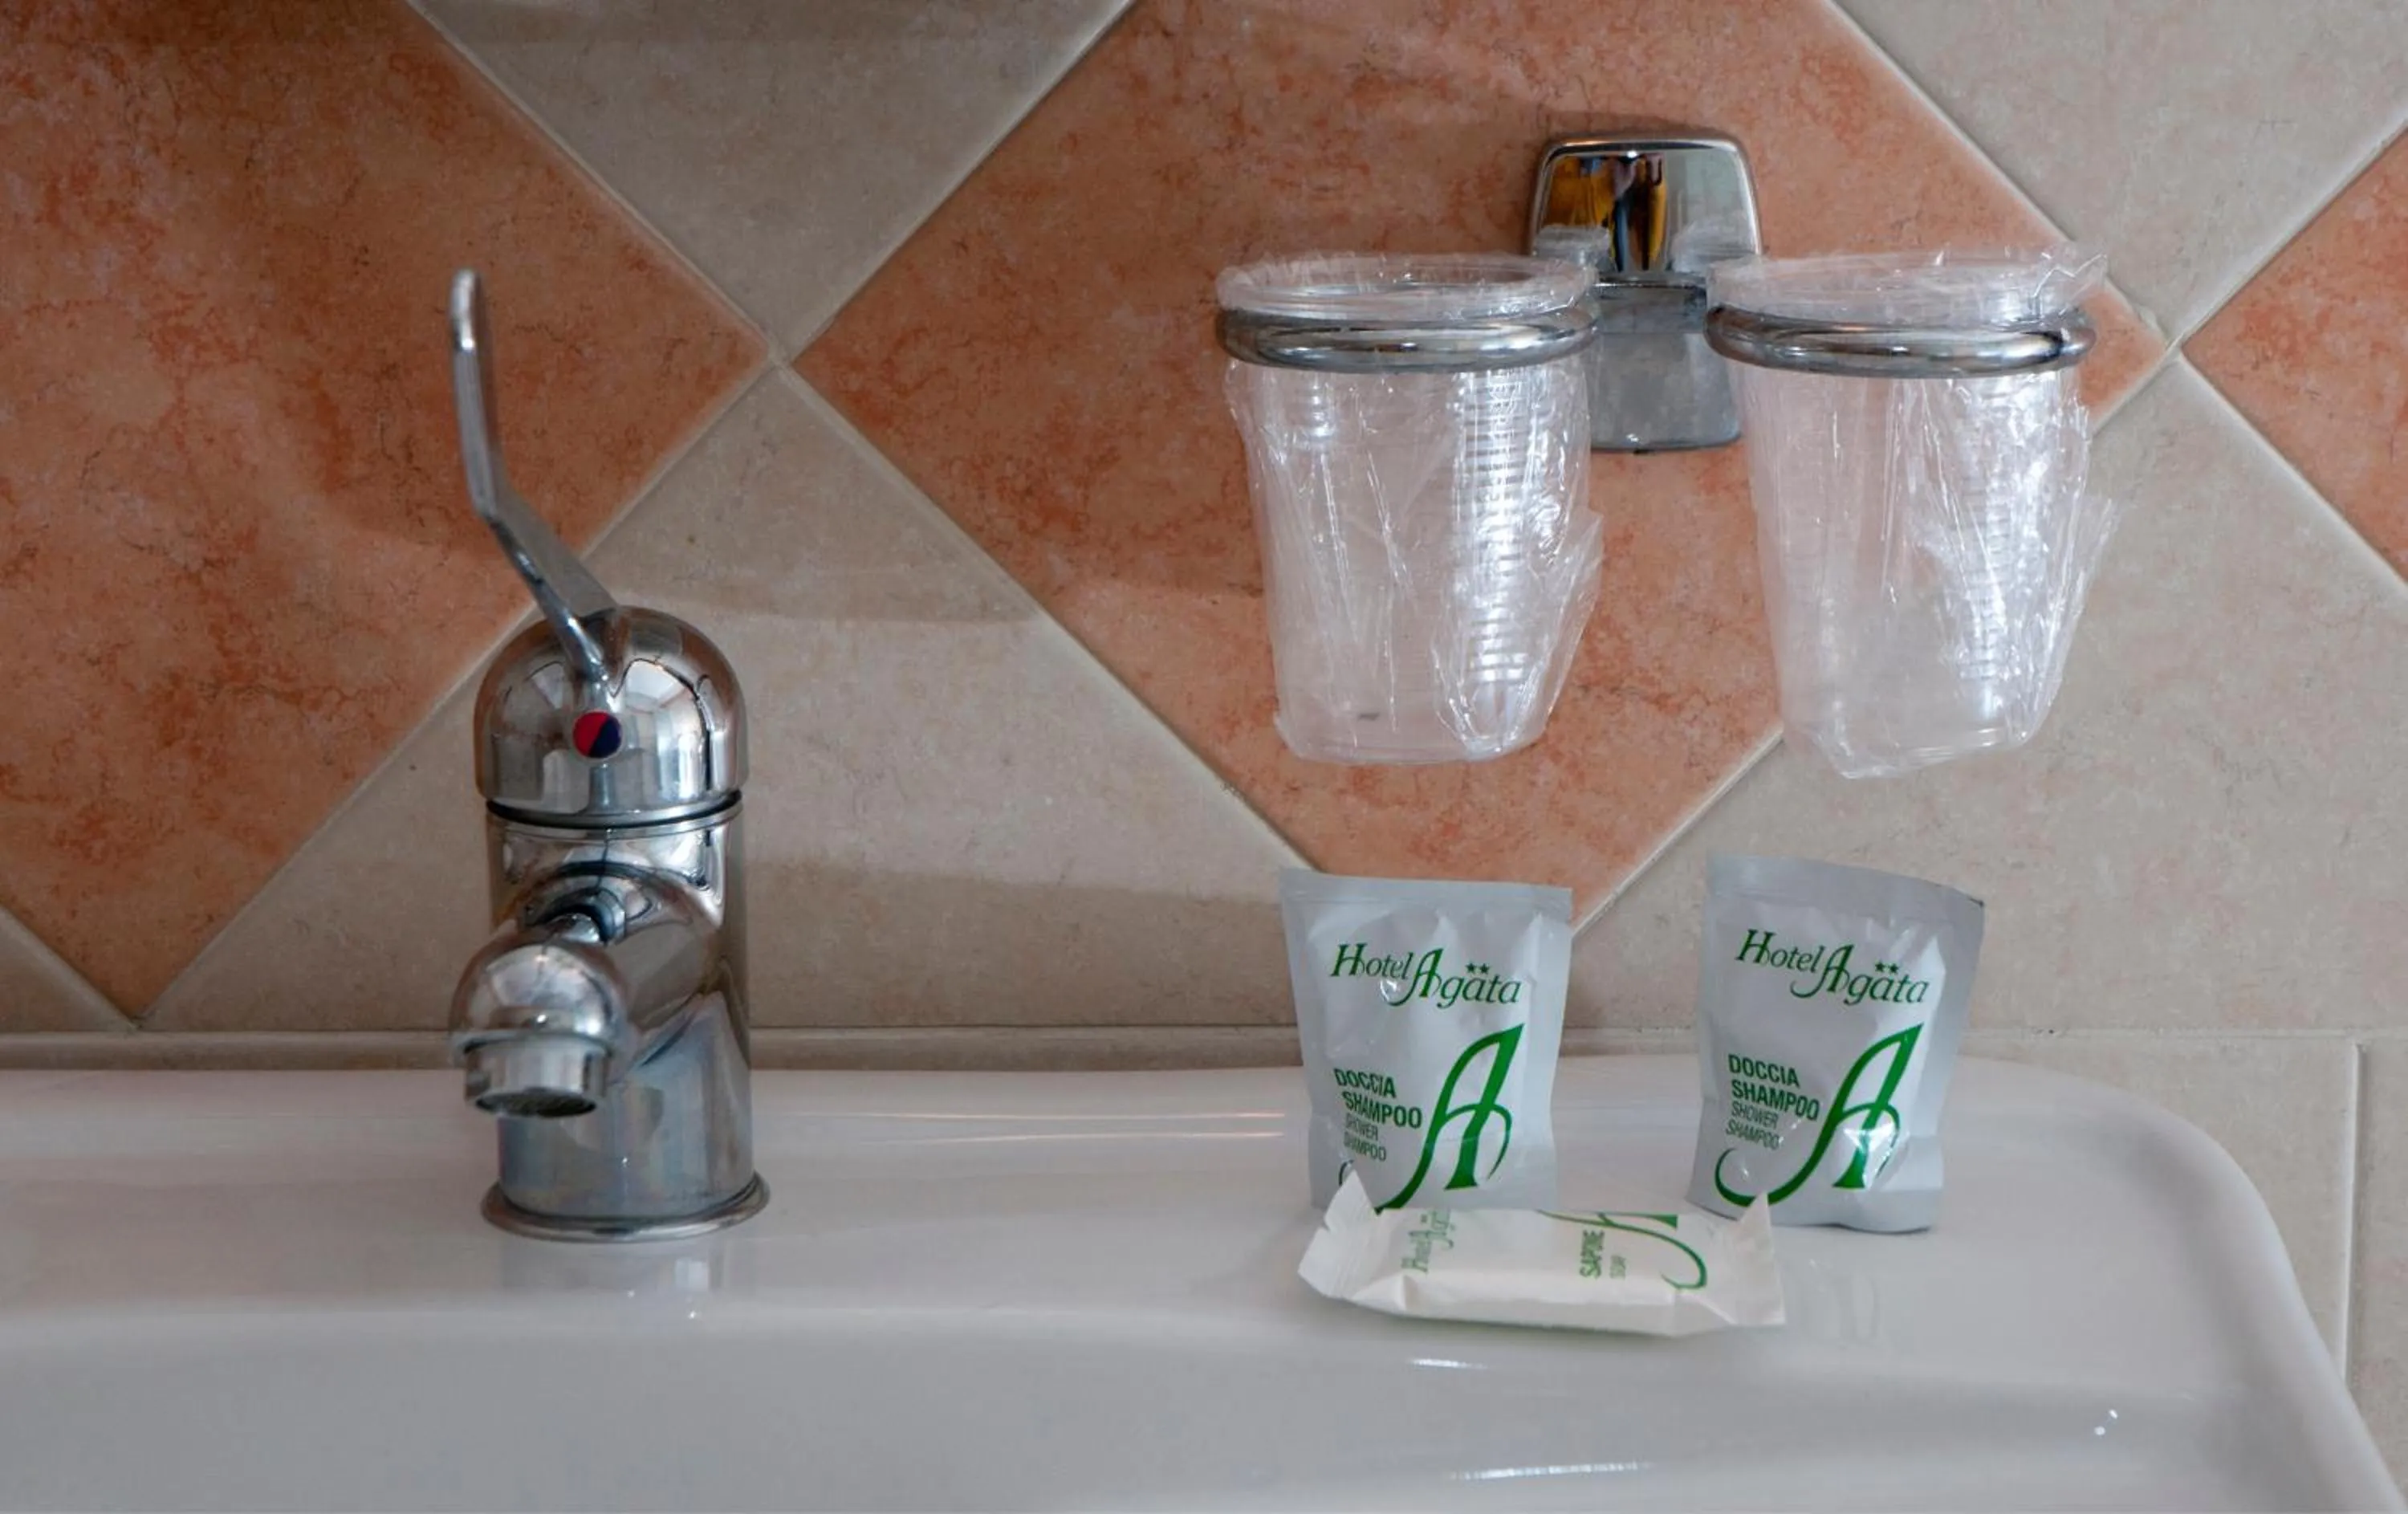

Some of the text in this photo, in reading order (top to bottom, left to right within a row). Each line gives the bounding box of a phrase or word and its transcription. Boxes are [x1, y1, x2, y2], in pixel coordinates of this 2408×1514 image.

[1329, 942, 1414, 980] Hotel
[1735, 928, 1826, 974] Hotel
[1332, 1068, 1397, 1099] DOCCIA
[1727, 1053, 1800, 1089] DOCCIA
[1341, 1091, 1423, 1129] SHAMPOO
[1731, 1078, 1820, 1122] SHAMPOO
[1731, 1100, 1780, 1129] SHOWER
[1725, 1118, 1780, 1151] SHAMPOO
